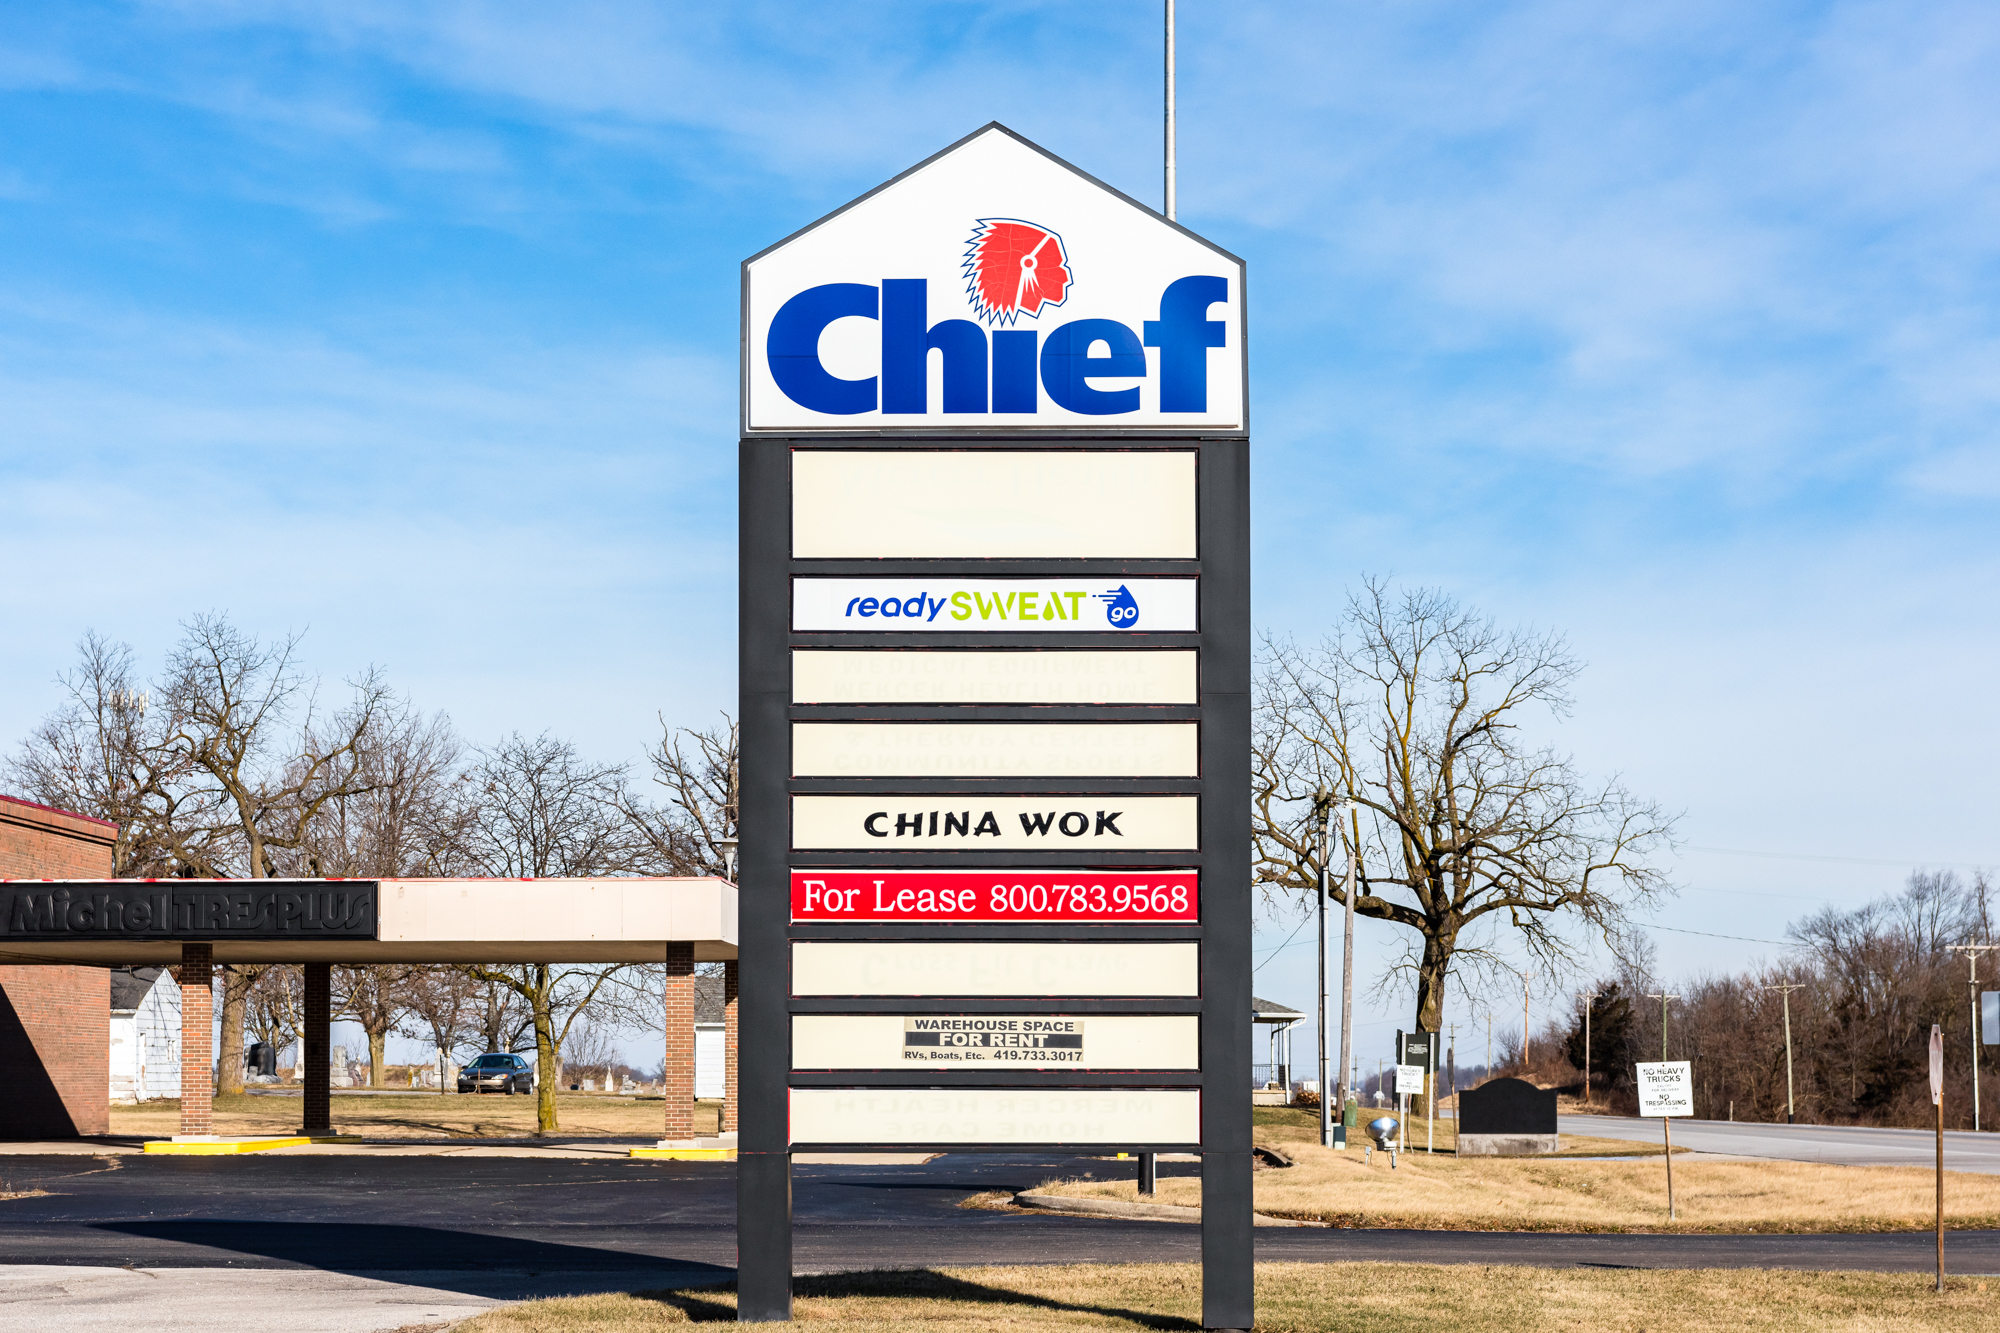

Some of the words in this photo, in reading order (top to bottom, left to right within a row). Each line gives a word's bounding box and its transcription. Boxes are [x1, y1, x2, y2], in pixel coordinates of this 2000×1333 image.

[767, 274, 1228, 416] Chief
[1110, 607, 1136, 623] go
[863, 810, 1002, 838] CHINA
[1018, 810, 1124, 838] WOK
[802, 880, 861, 913] For
[873, 880, 976, 913] Lease
[989, 884, 1189, 913] 800.783.9568
[10, 888, 167, 932] Michel
[914, 1019, 1018, 1031] WAREHOUSE
[1022, 1020, 1074, 1032] SPACE
[939, 1032, 983, 1047] FOR
[989, 1033, 1049, 1048] RENT
[904, 1051, 928, 1060] RVs,
[930, 1051, 962, 1061] Boats,
[965, 1051, 985, 1060] Etc.
[993, 1050, 1083, 1062] 419.733.3017
[1647, 1075, 1681, 1083] TRUCKS
[1657, 1067, 1685, 1075] HEAVY
